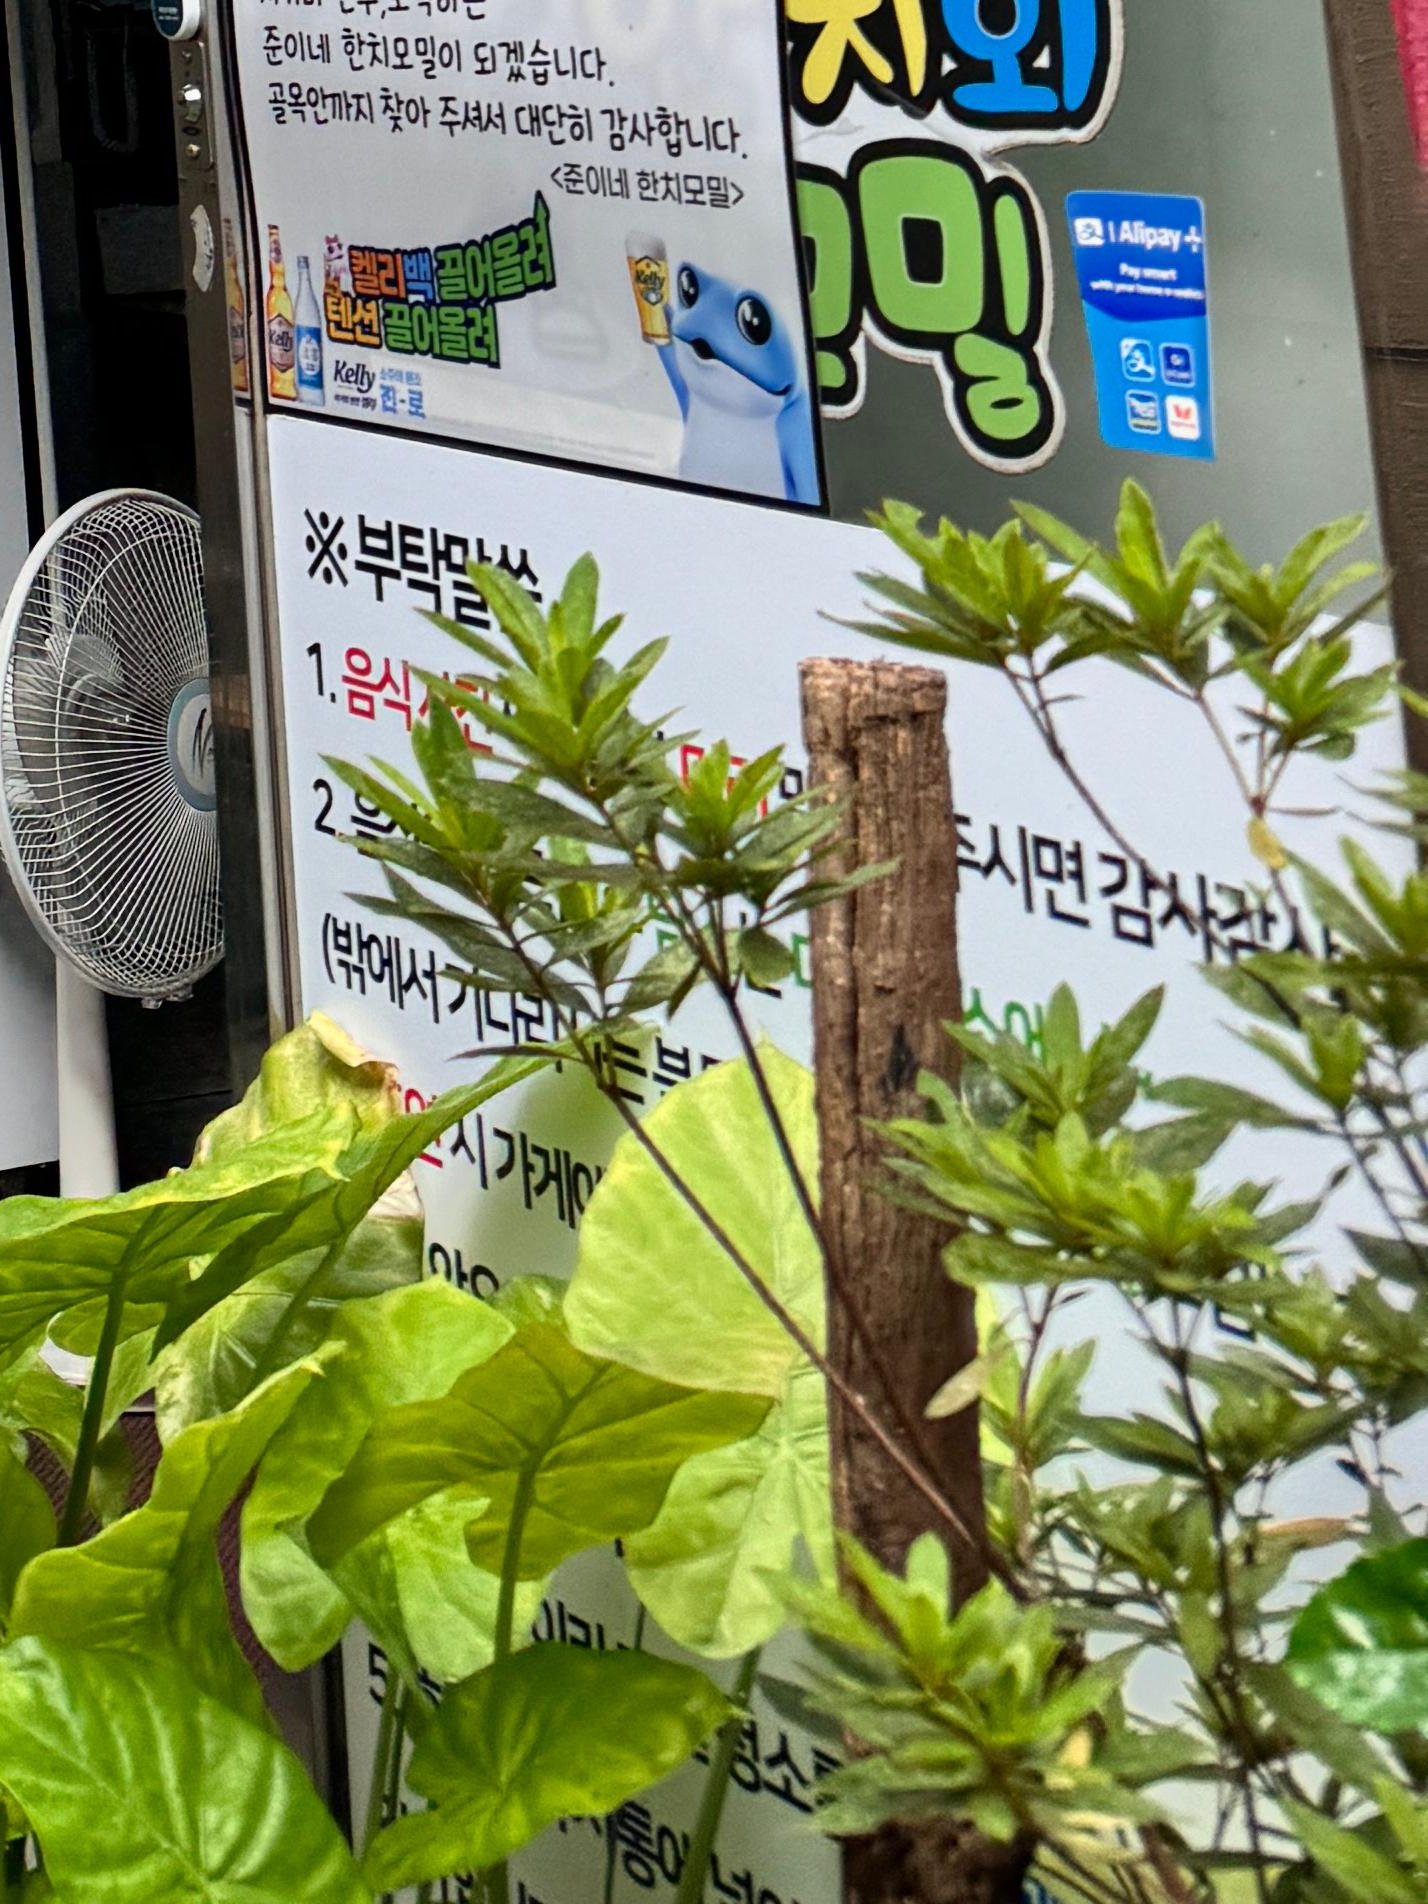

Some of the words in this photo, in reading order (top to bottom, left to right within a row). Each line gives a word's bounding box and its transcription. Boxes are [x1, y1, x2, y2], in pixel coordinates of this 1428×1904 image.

[261, 25, 332, 67] 준이네
[341, 27, 463, 80] 한치모밀이
[473, 40, 616, 87] 되겠습니다.
[267, 80, 375, 125] 골목안까지
[380, 88, 431, 133] 찾아
[439, 95, 508, 136] 주셔서
[515, 101, 594, 146] 대단히
[600, 106, 749, 160] 감사합니다.
[326, 295, 382, 347] 텐션
[333, 359, 376, 394] Kelly
